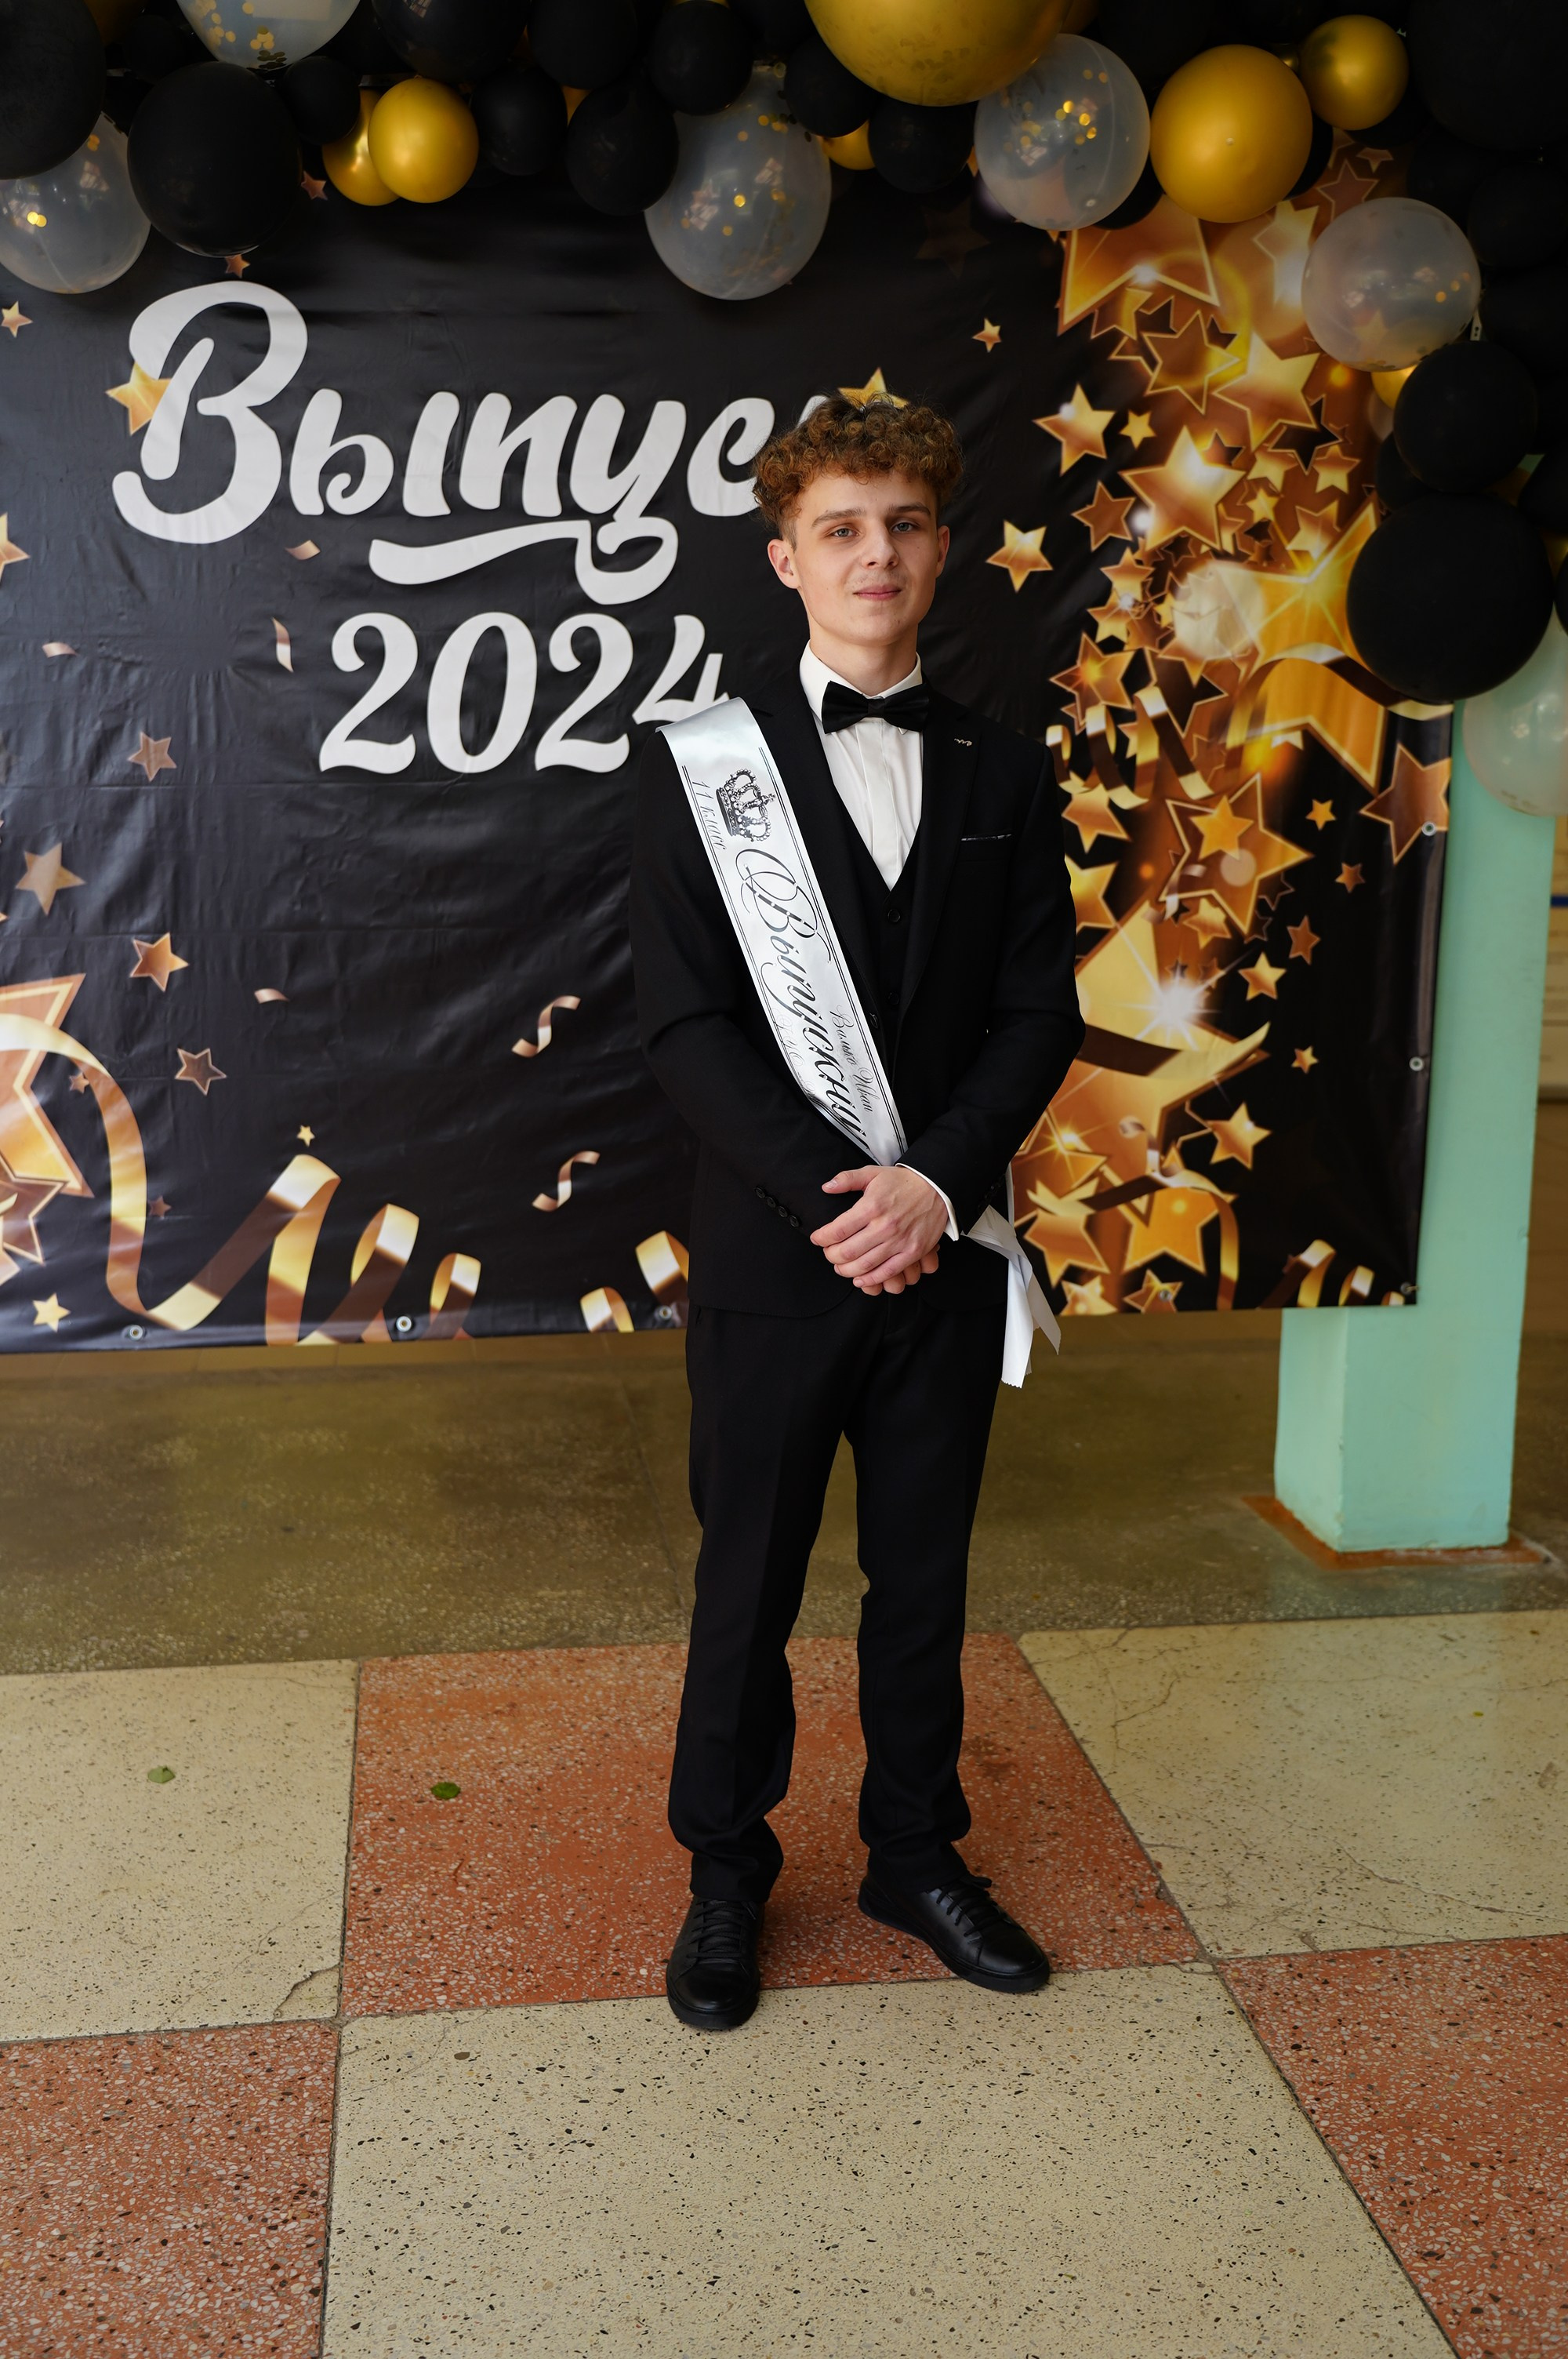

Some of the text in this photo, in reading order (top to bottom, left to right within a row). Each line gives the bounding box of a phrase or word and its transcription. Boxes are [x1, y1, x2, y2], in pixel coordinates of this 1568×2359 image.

[112, 280, 829, 605] Выпус
[319, 611, 730, 774] 2024
[691, 780, 727, 850] 11 класс
[851, 1067, 880, 1112] Иван
